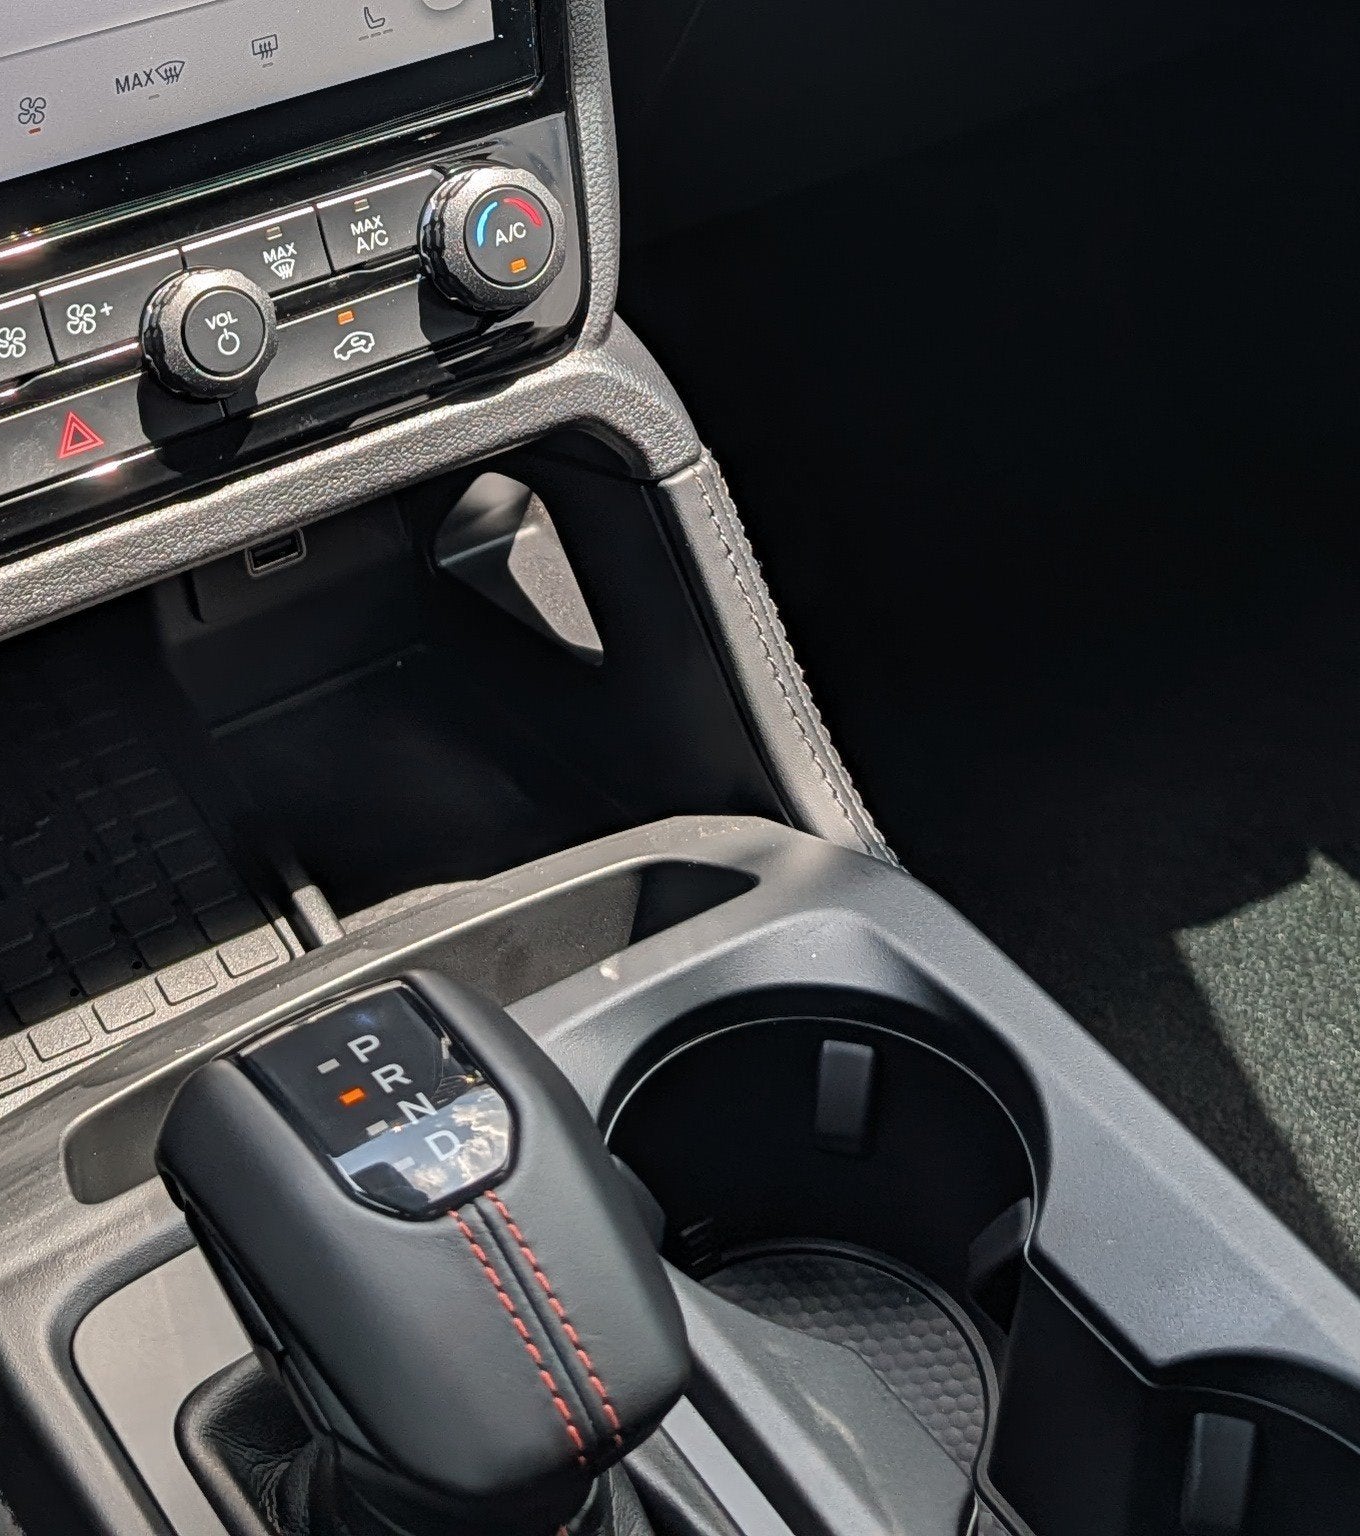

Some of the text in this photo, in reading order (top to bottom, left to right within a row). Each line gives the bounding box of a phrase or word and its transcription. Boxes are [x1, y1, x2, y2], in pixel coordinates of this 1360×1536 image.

[115, 68, 155, 95] MAX
[350, 215, 384, 236] MAX
[494, 222, 527, 247] A/C
[263, 242, 297, 264] MAX
[356, 230, 389, 254] A/C
[205, 311, 238, 330] VOL
[347, 1034, 380, 1063] P
[371, 1063, 413, 1094] R
[397, 1092, 439, 1125] N
[424, 1129, 462, 1162] D
